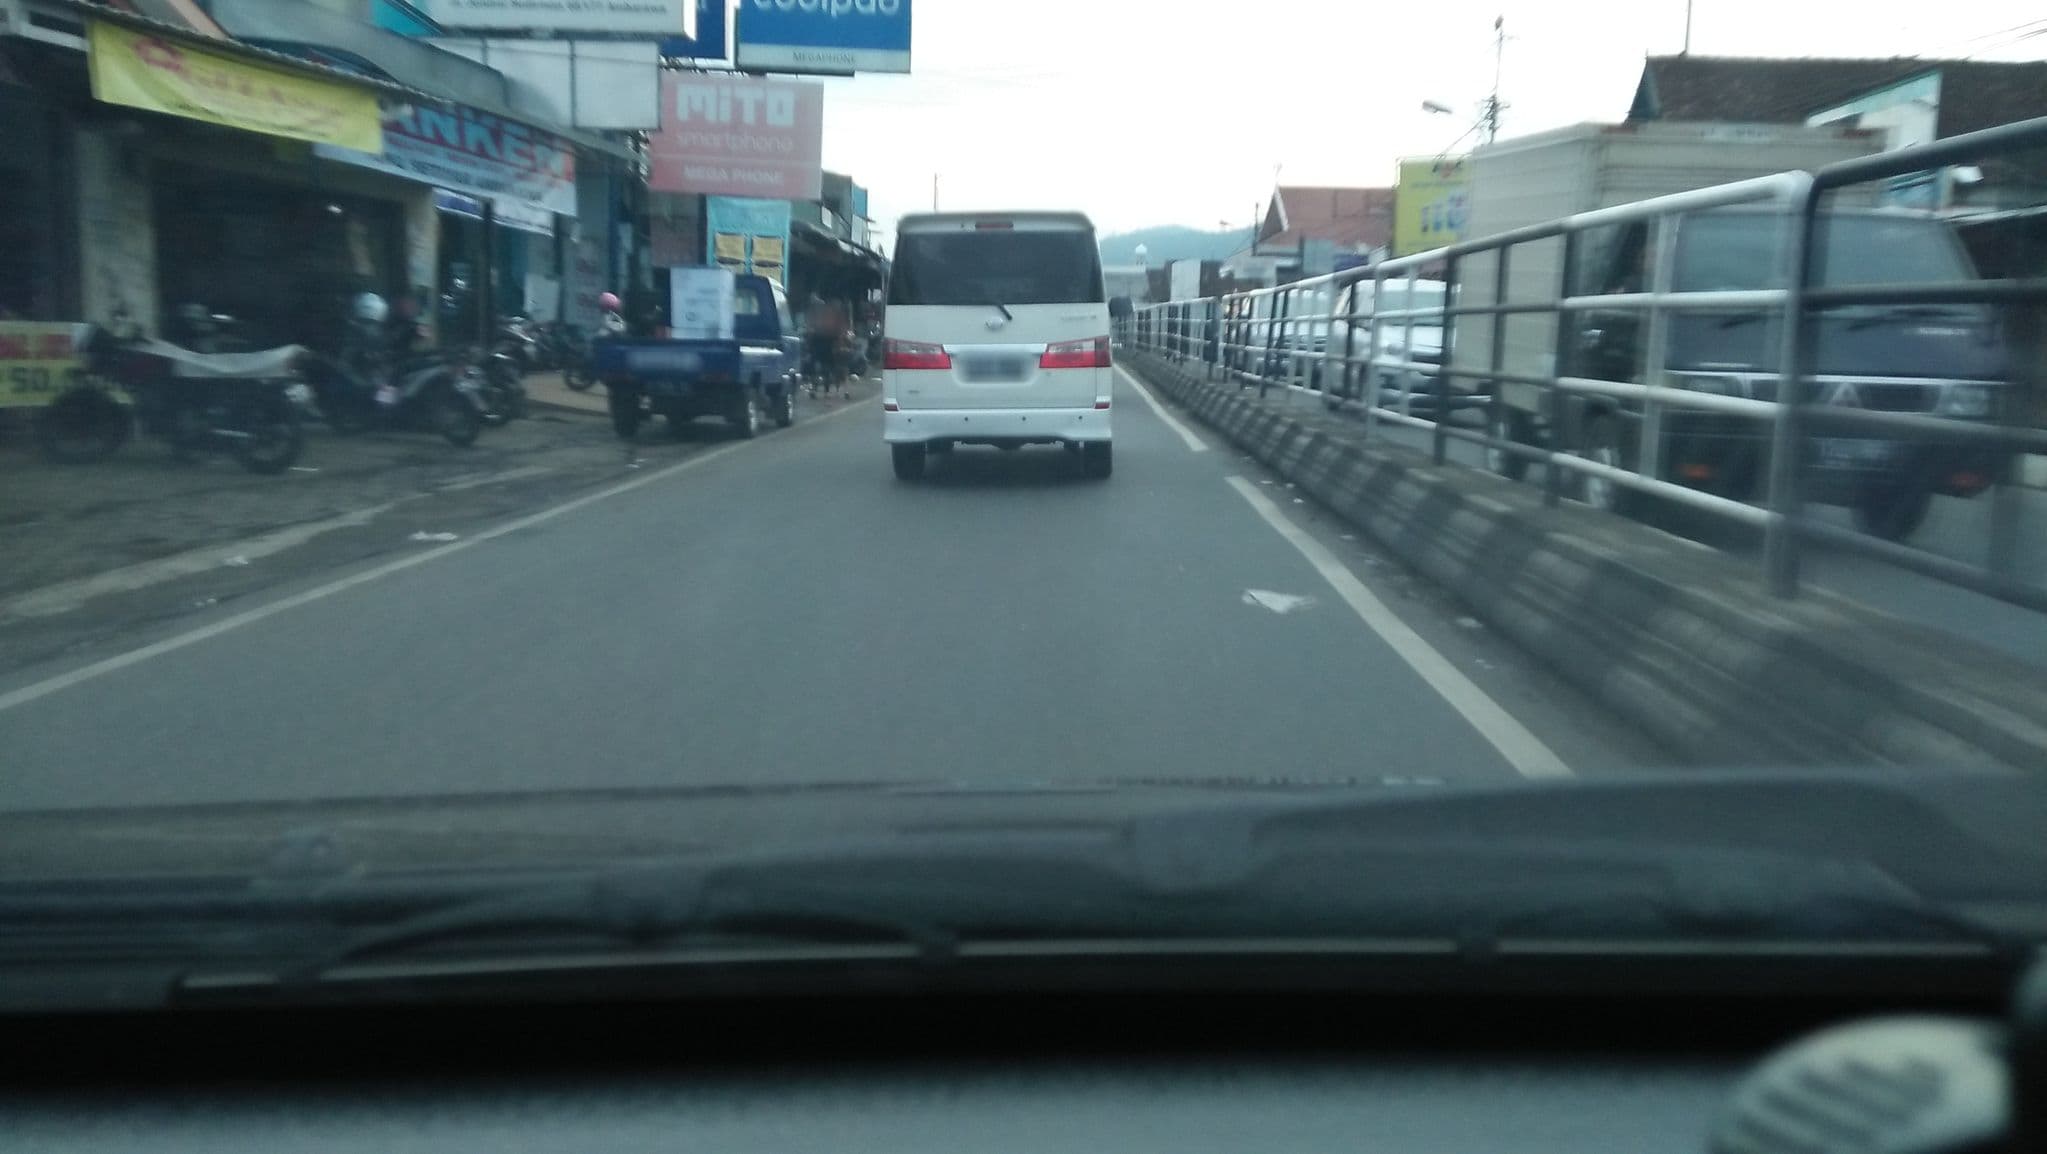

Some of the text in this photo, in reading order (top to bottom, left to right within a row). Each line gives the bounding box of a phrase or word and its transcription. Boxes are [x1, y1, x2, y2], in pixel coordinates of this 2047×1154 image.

[677, 131, 794, 155] smartphone
[683, 164, 786, 187] MEGA PHONE
